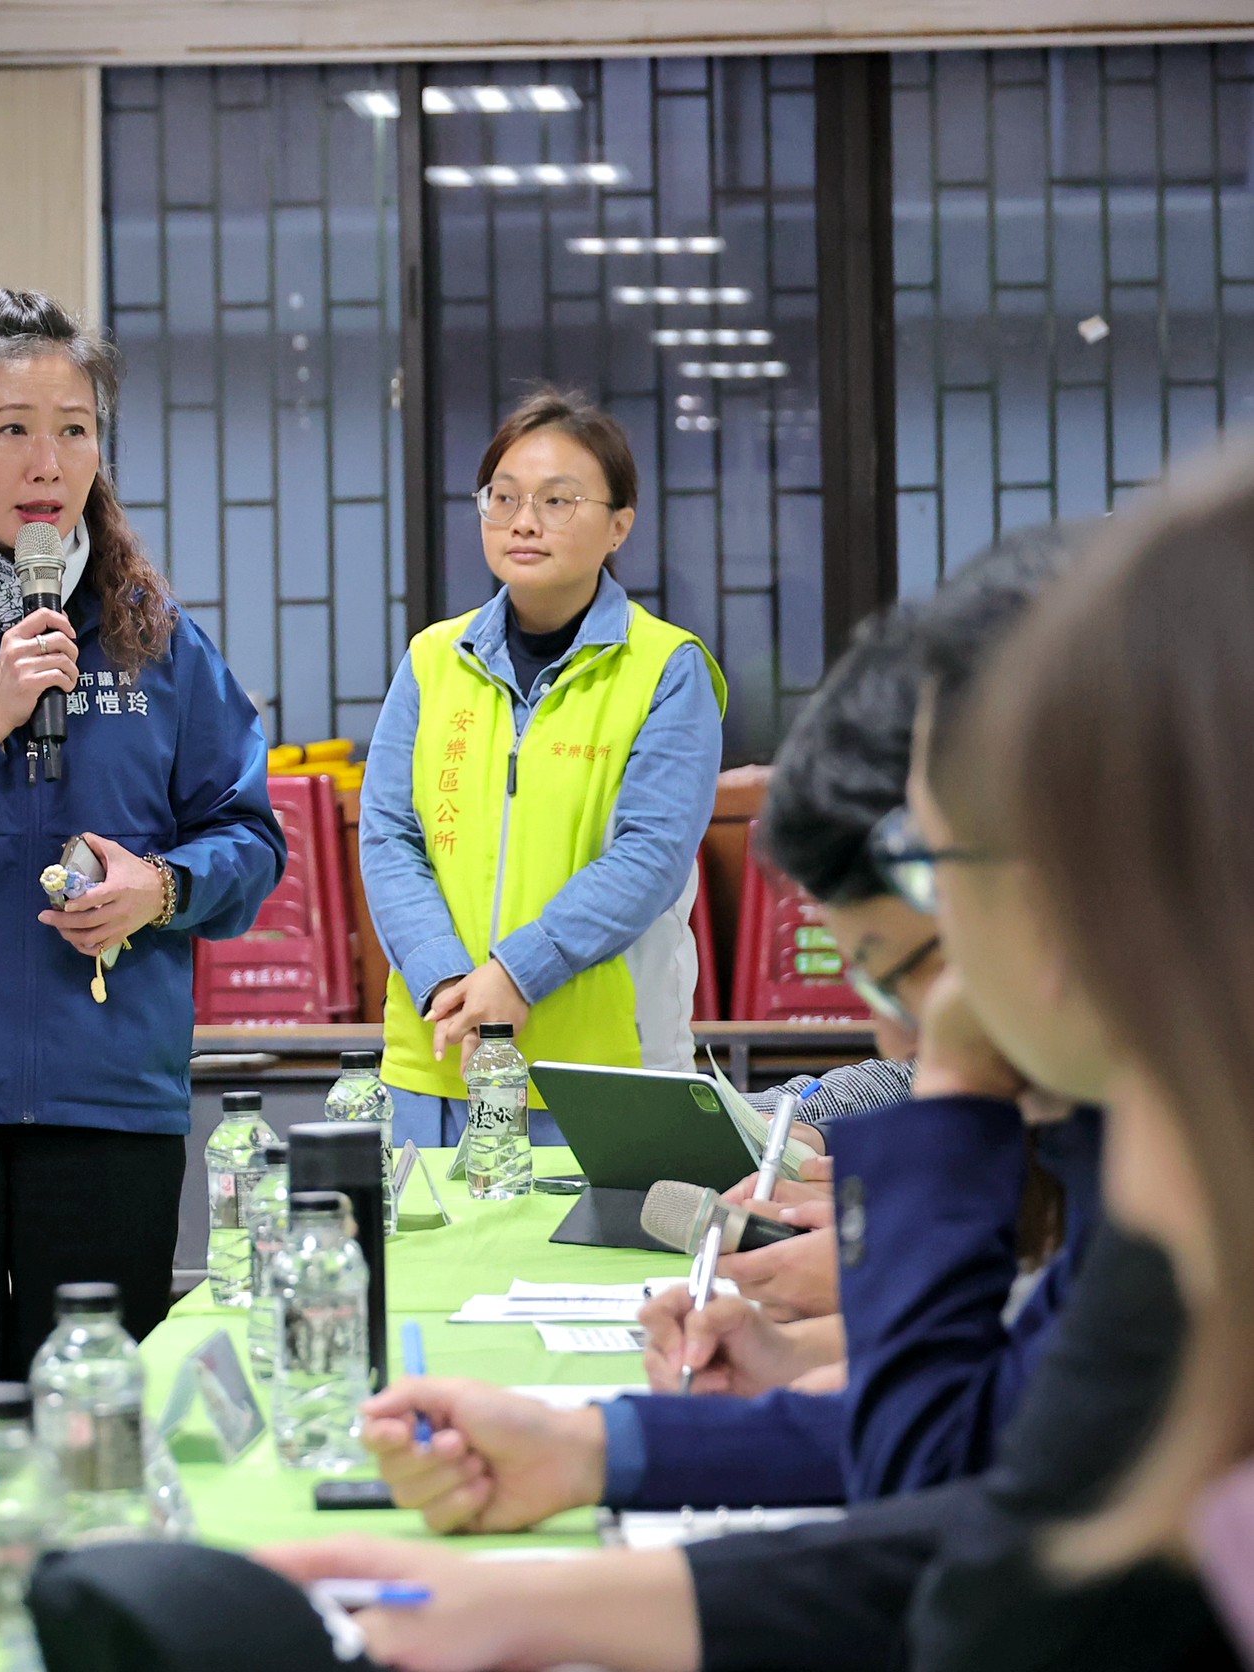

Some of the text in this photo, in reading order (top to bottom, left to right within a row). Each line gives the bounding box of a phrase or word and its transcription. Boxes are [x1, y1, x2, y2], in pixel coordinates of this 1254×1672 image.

[79, 671, 132, 687] 市議員
[66, 689, 149, 717] 鄭愷玲
[433, 708, 475, 857] 安樂區公所
